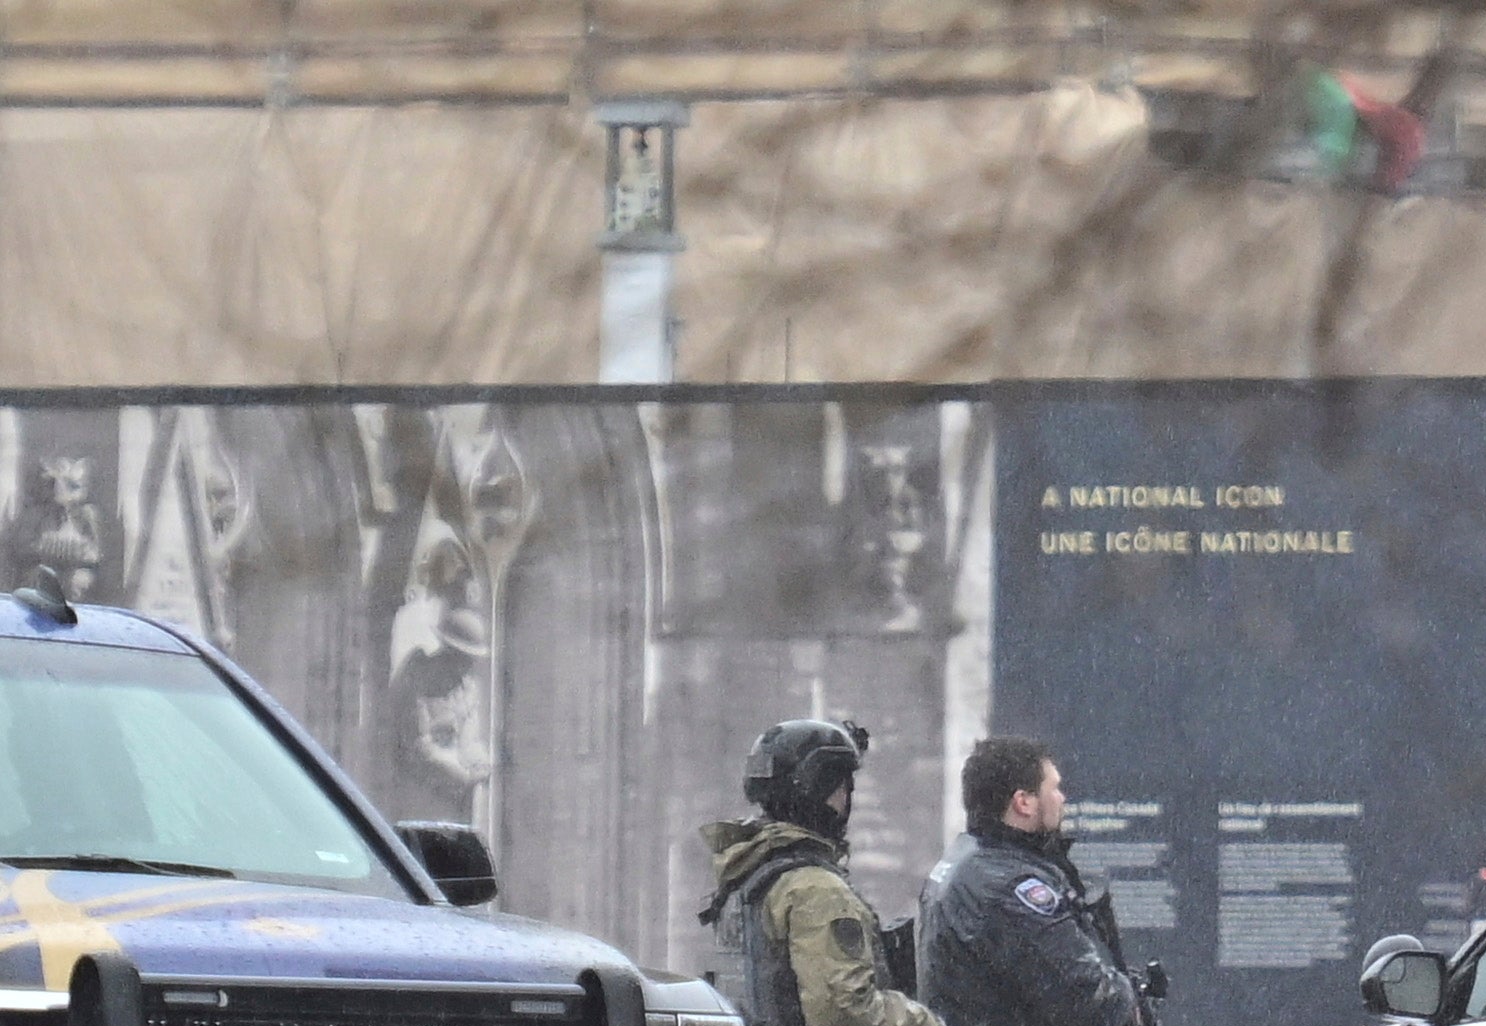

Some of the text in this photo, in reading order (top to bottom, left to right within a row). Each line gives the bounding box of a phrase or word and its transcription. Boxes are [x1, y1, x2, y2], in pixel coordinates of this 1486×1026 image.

[1041, 486, 1285, 507] A NATIONAL ICON
[1041, 526, 1354, 553] UNE ICÔNE NATIONALE
